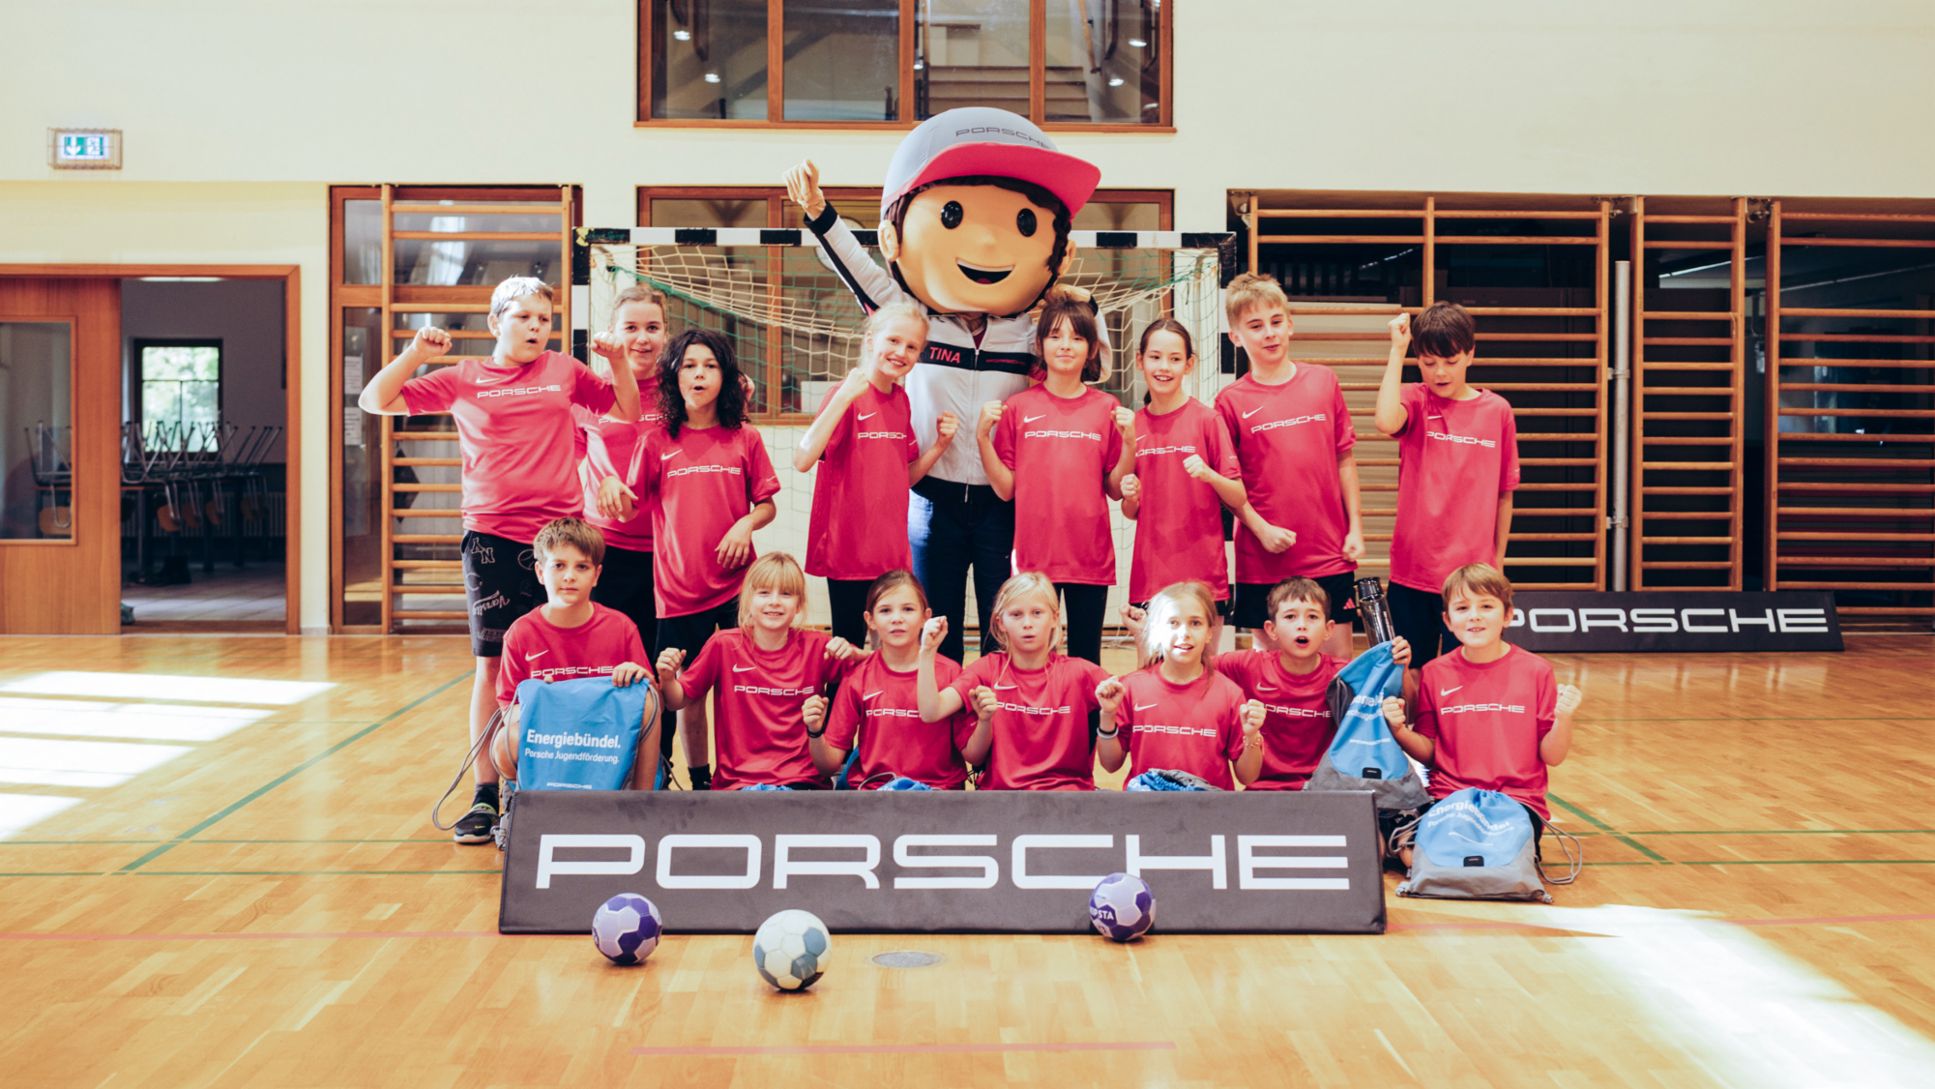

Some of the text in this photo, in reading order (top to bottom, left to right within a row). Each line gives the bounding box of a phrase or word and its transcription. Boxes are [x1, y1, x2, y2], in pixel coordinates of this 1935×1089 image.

[929, 346, 961, 363] TINA
[477, 384, 561, 399] PORSCHE
[1251, 413, 1326, 434] PORSCHE
[1024, 429, 1101, 441] PORSCHE
[1135, 445, 1196, 457] ORSCHE
[667, 464, 742, 479] PORSCHE
[734, 685, 815, 697] PORSCHE
[1440, 703, 1525, 715] PORSCHE
[526, 728, 622, 749] Energiebündel.
[1132, 725, 1217, 738] PORSCHE
[524, 748, 620, 765] Porsche Jugendförderung.
[535, 833, 1351, 890] PORSCHE
